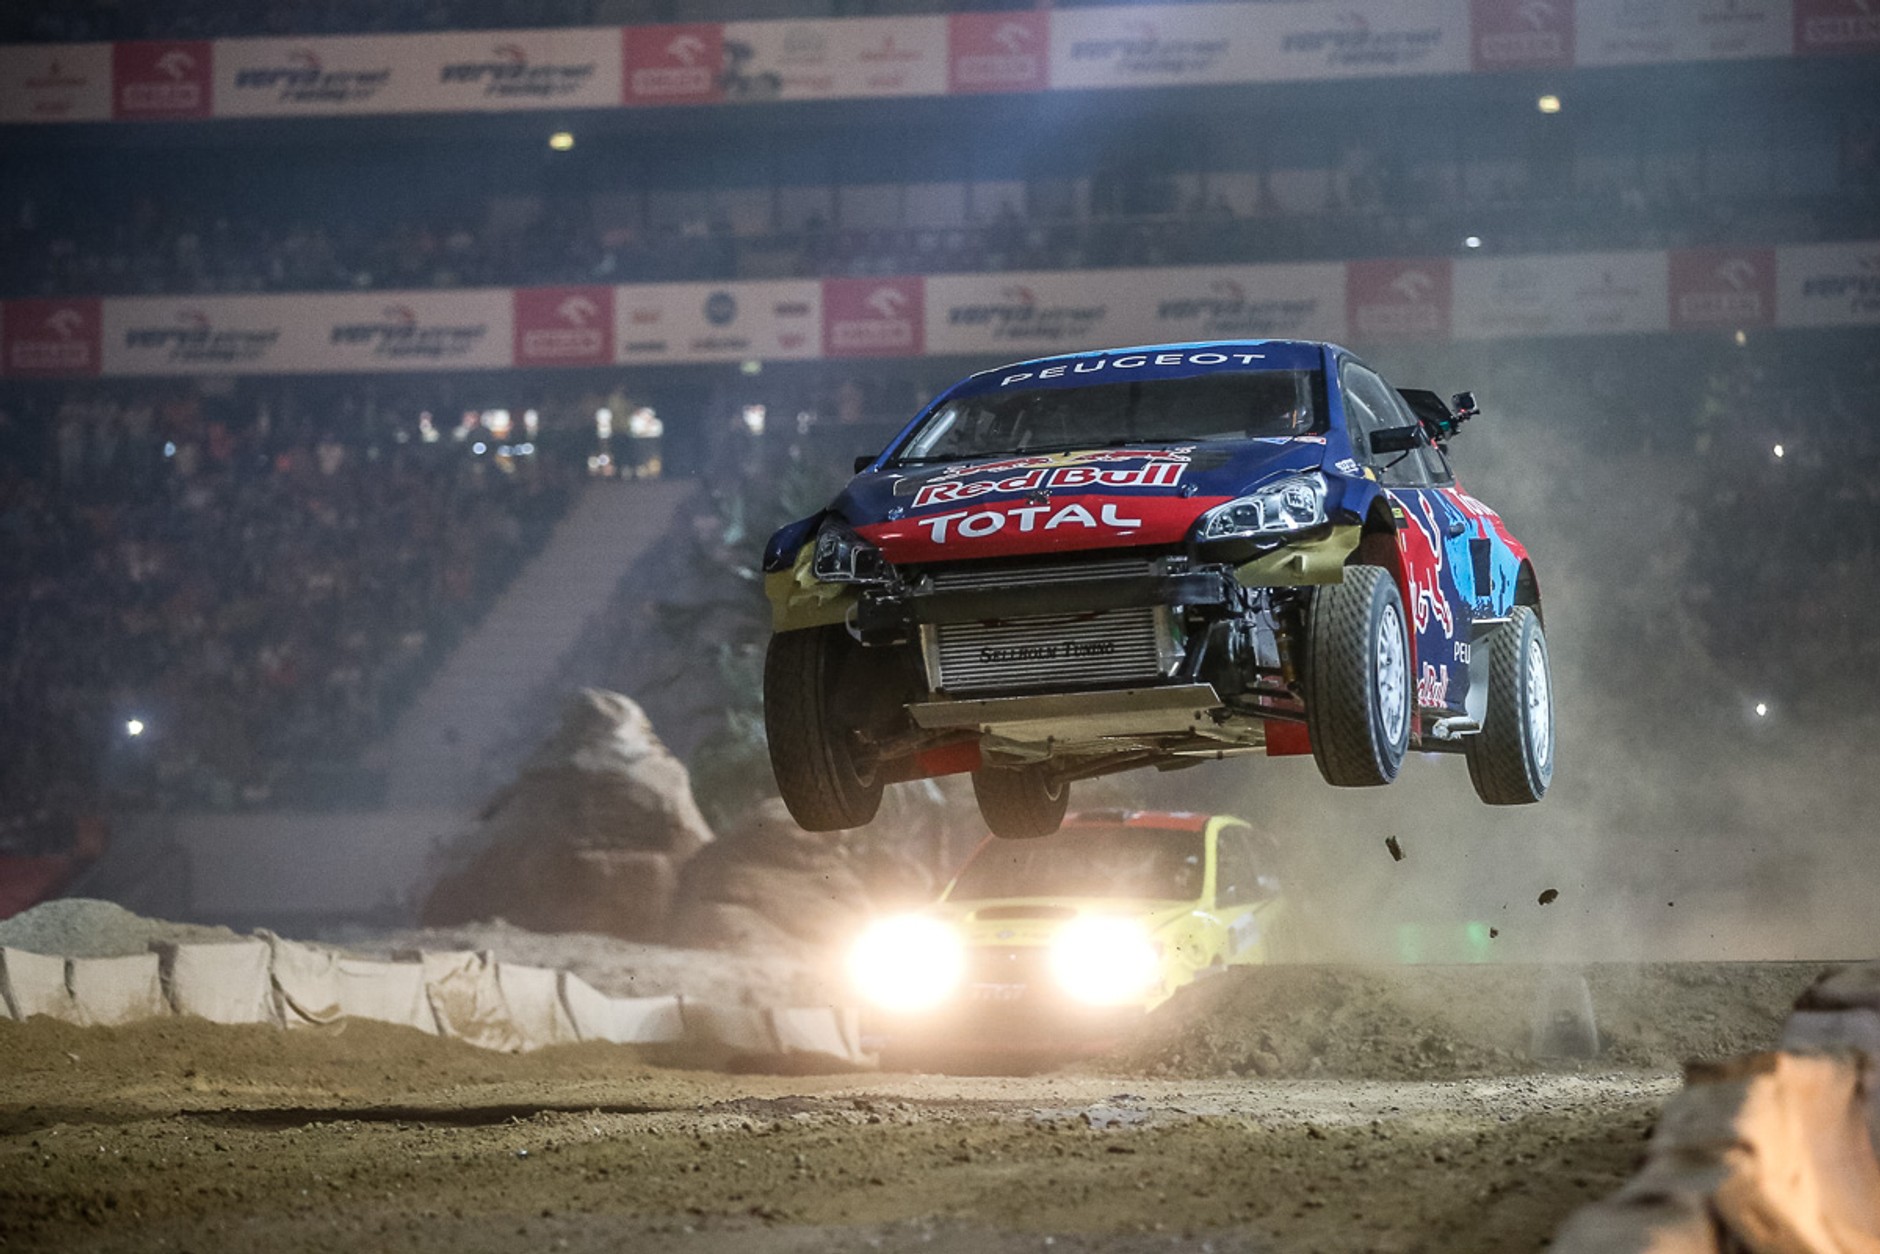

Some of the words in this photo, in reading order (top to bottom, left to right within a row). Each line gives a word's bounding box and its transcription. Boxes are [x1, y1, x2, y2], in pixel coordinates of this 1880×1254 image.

[1000, 353, 1265, 386] PEUGEOT
[911, 468, 1050, 508] Red
[1046, 462, 1190, 488] Bull
[918, 503, 1142, 544] TOTAL
